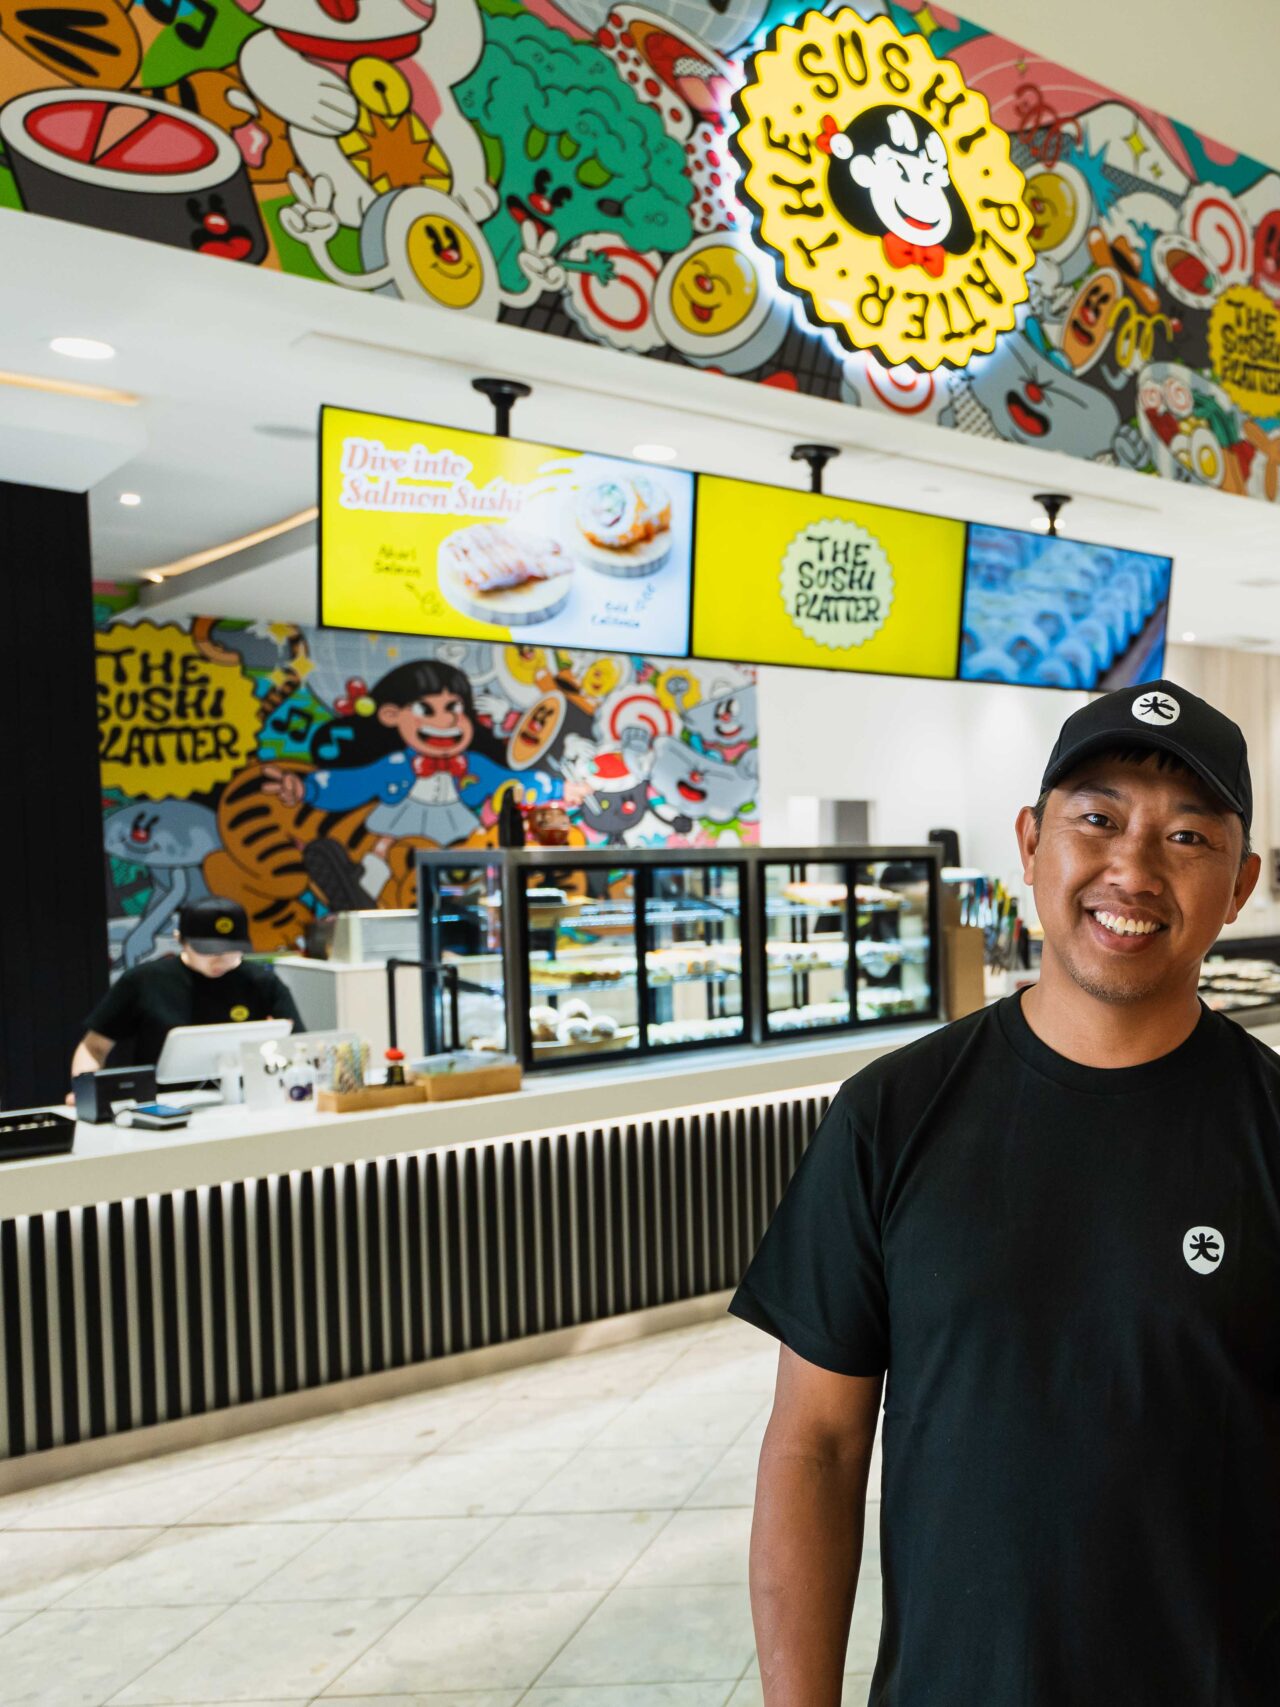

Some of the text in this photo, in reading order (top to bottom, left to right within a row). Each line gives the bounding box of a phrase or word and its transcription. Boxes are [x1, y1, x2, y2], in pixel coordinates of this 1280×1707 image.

[765, 29, 1021, 342] THE SUSHI PLATTER
[1225, 299, 1277, 338] THE
[346, 443, 467, 477] Dive into
[346, 477, 524, 513] Salmon Sushi
[806, 535, 871, 566] THE
[798, 560, 876, 593] SUSHI
[795, 592, 880, 624] PLATTER
[95, 647, 210, 685] THE
[96, 683, 225, 723] SUSHI
[99, 723, 241, 767] LATTER
